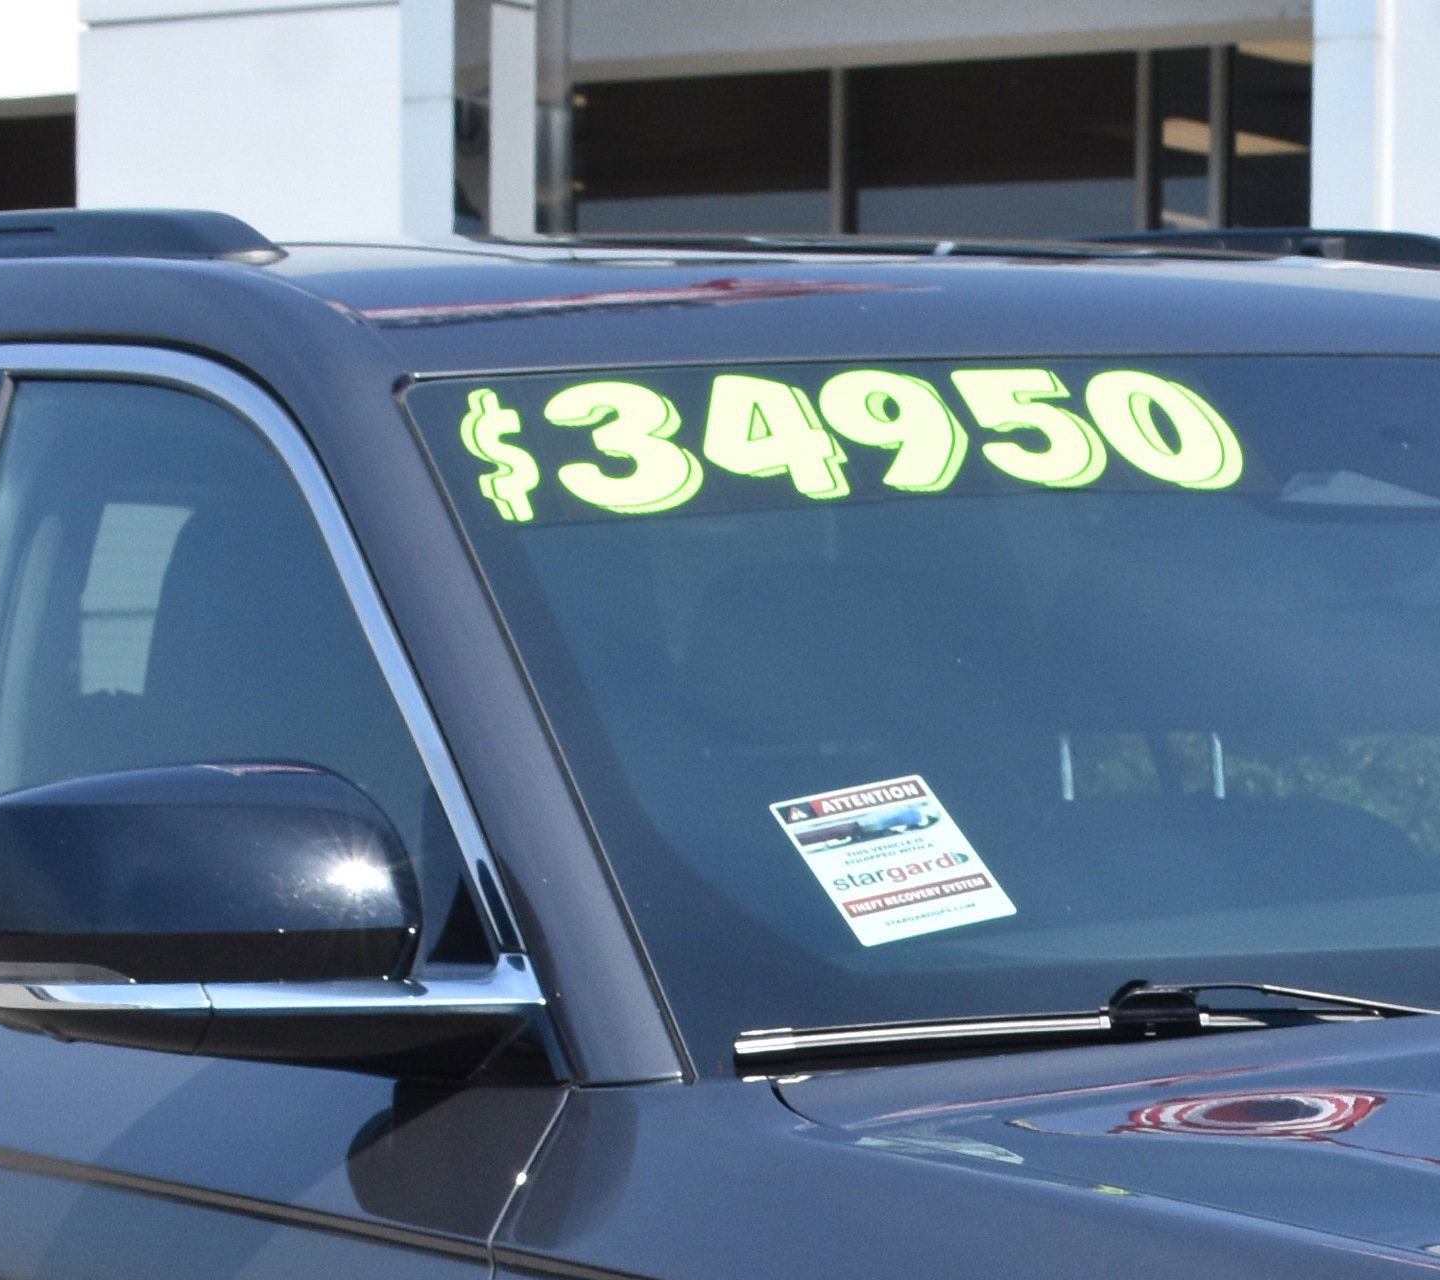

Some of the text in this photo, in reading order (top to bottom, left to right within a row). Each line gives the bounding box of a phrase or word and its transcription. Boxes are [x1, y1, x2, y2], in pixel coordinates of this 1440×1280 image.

[460, 369, 1244, 522] $34950
[821, 783, 919, 814] ATTENTION
[833, 852, 955, 891] stargard
[848, 877, 986, 914] THEFT RECOVERY SYSTEM
